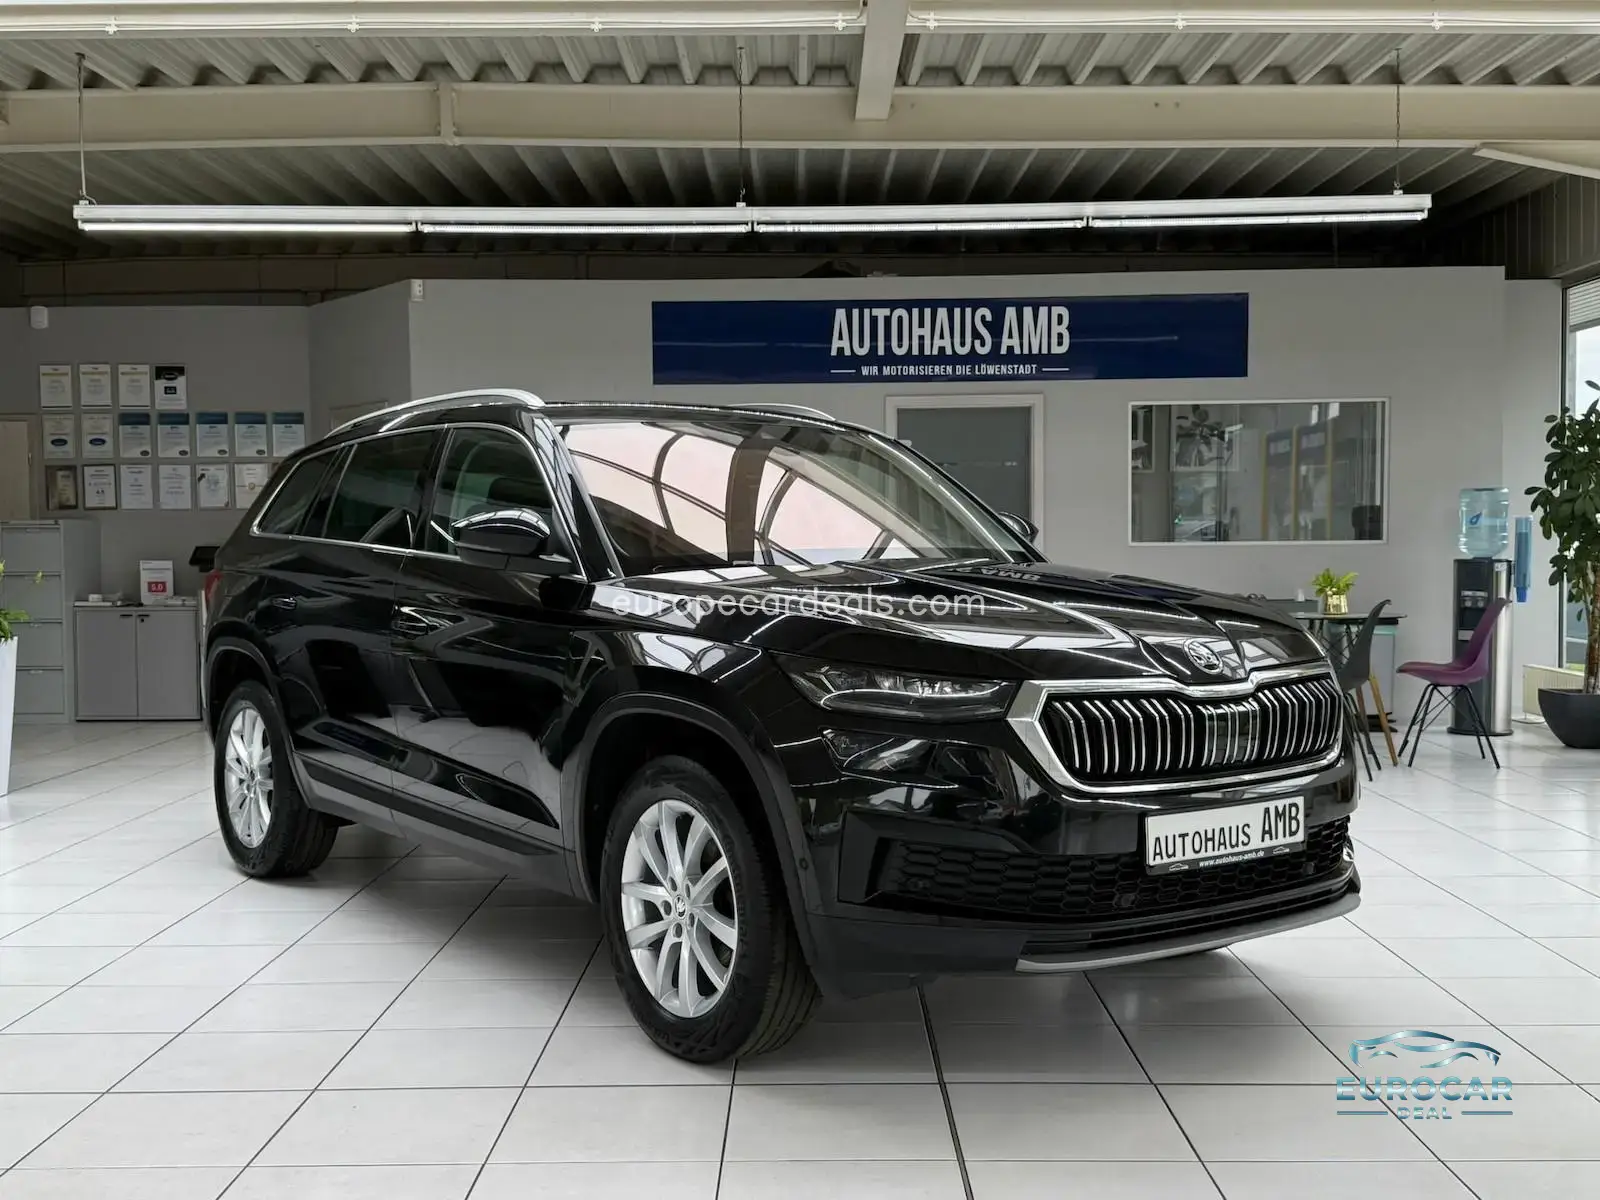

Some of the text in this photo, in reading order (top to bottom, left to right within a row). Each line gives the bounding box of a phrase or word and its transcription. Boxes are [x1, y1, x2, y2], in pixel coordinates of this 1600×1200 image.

[830, 306, 1070, 356] AUTOHAUS AMB
[861, 363, 1037, 376] WIR MOTORISIEREN DIE LÖWENSTADT
[1152, 802, 1301, 861] AUTOHAUS AMB
[1198, 850, 1265, 868] www.autohaus-amb.de
